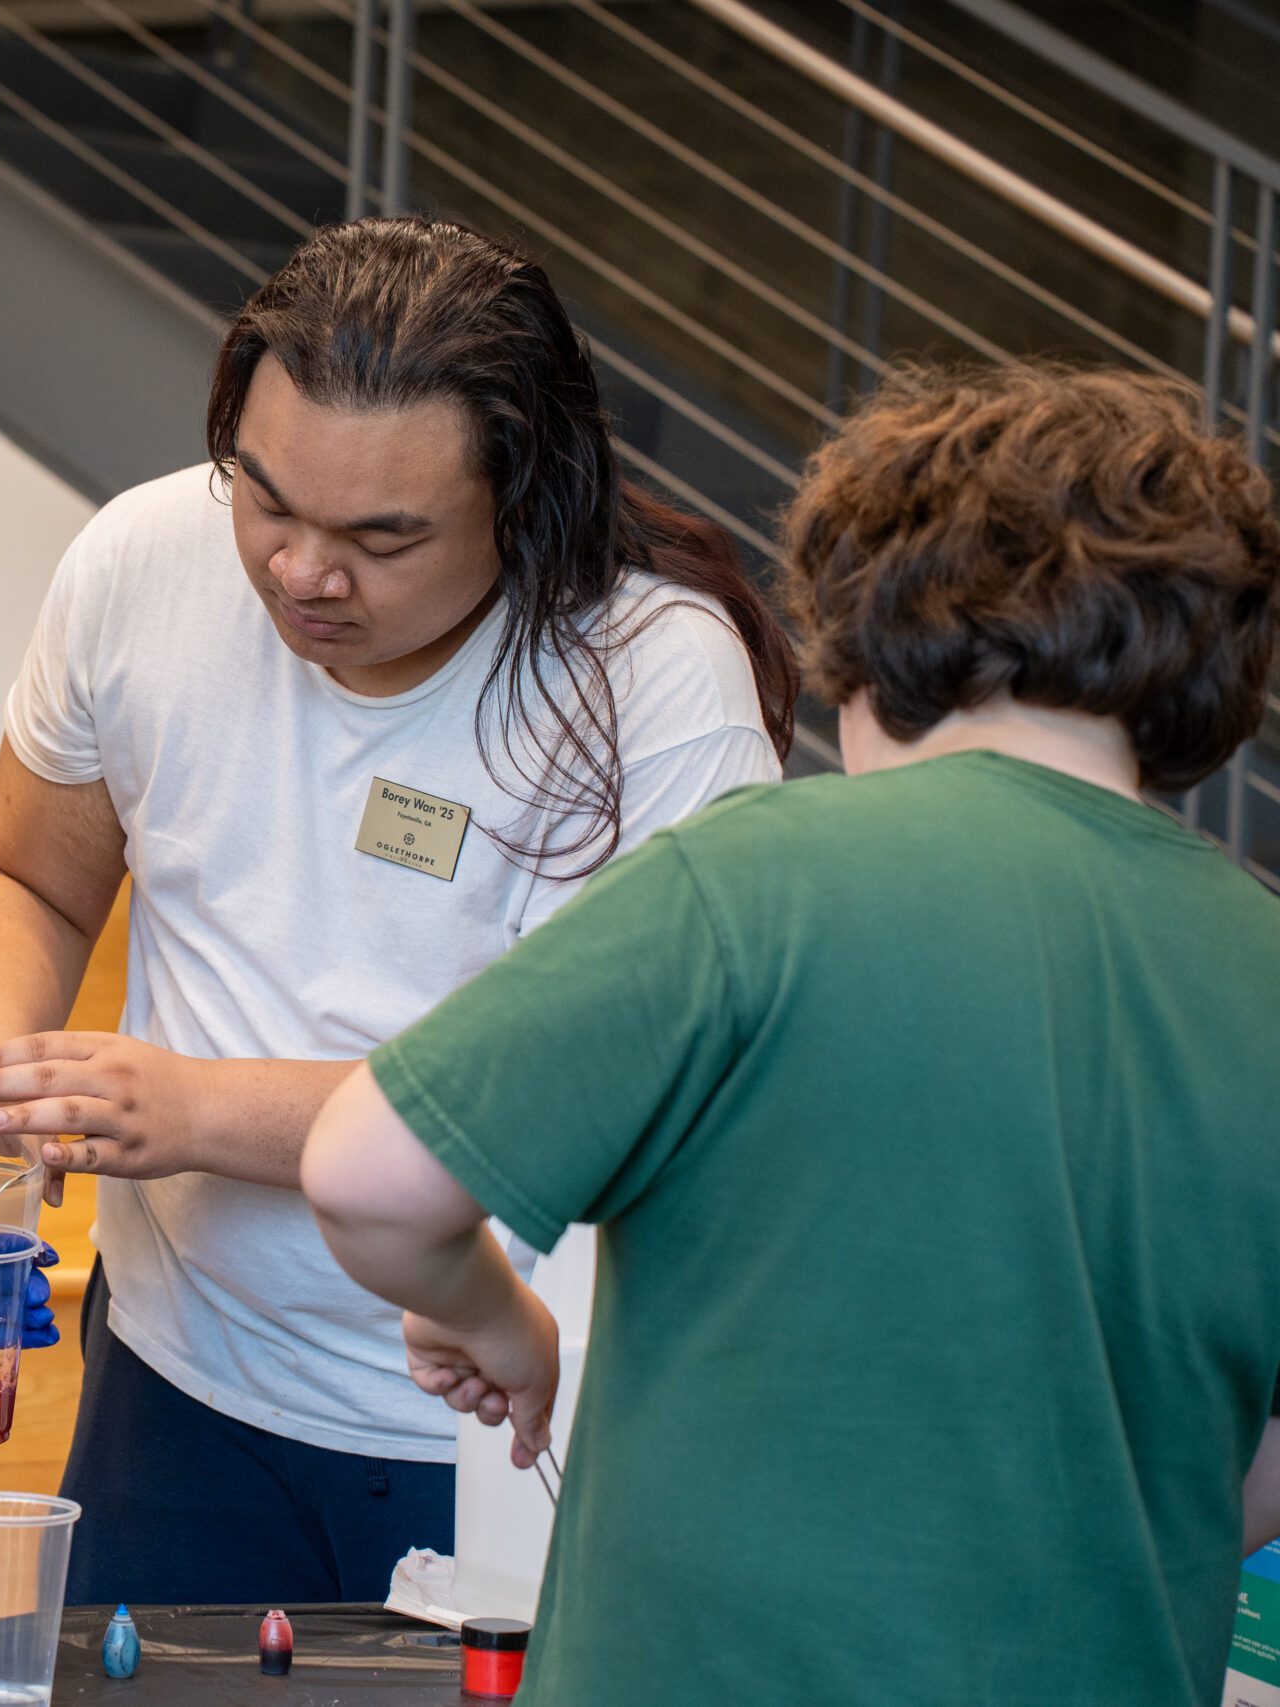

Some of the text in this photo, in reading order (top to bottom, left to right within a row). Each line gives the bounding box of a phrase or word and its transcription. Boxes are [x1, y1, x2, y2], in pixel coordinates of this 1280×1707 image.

[382, 788, 455, 820] Borey Wan '25
[376, 841, 435, 866] OGLETHORPE
